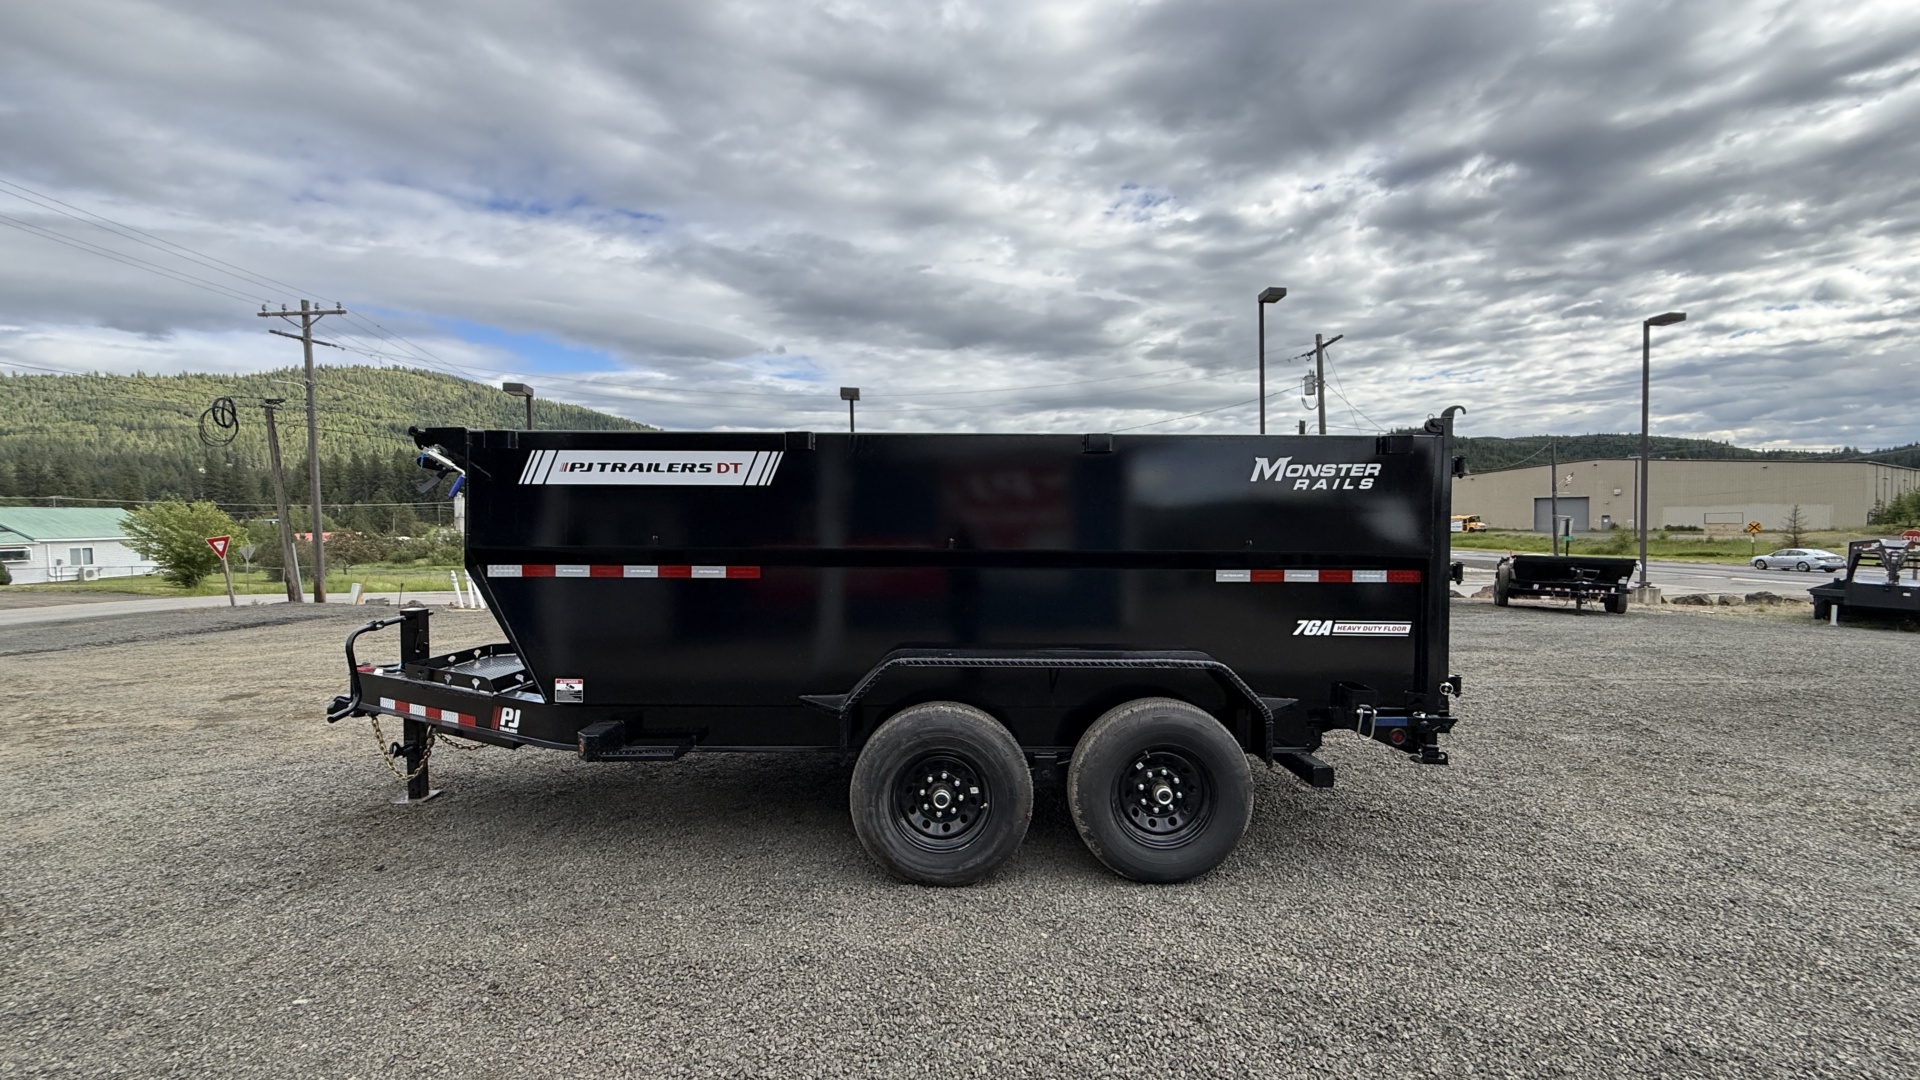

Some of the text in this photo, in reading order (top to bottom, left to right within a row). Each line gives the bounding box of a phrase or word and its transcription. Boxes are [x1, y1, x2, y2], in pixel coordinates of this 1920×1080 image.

[569, 462, 742, 474] PJ TRAILERS DT
[1293, 478, 1374, 491] RAILS
[1292, 620, 1333, 636] 7GA
[500, 707, 521, 728] PJ
